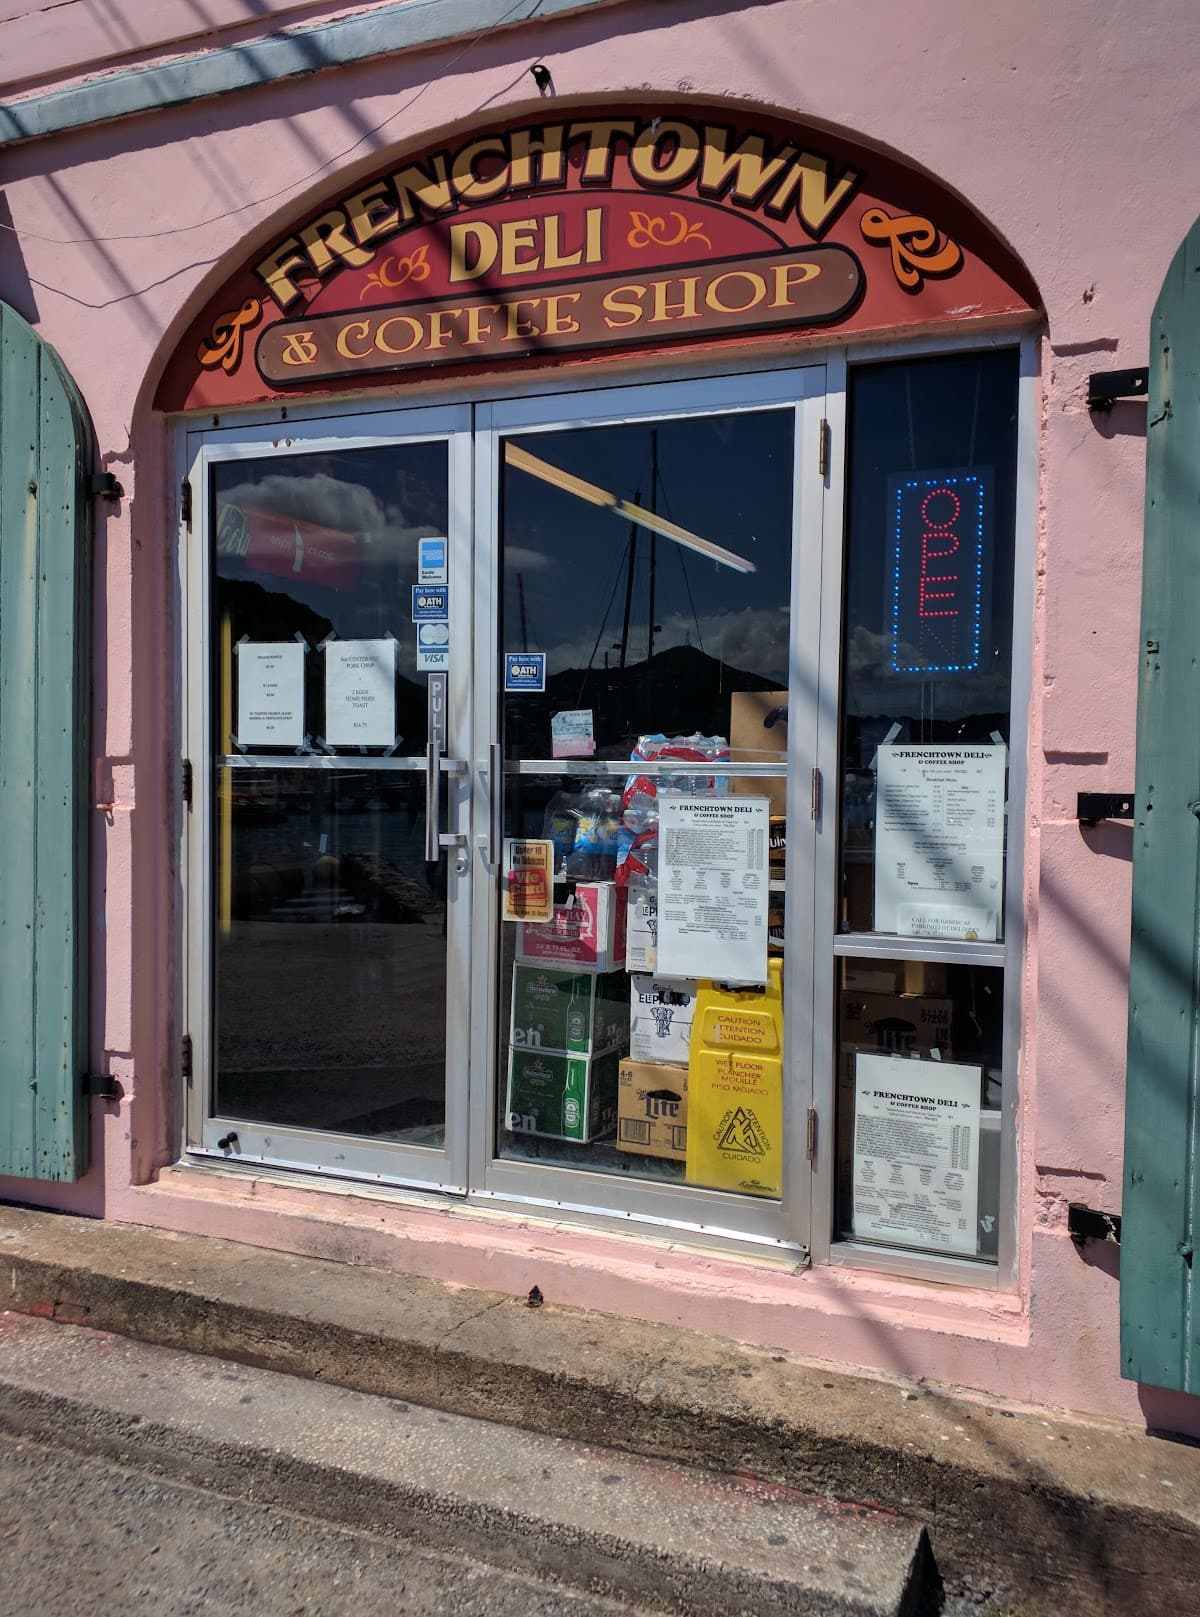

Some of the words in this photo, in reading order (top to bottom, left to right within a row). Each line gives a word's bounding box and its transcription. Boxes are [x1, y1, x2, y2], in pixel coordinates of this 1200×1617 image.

[255, 118, 862, 308] FRENCHTOWN
[449, 206, 604, 283] DELI
[282, 331, 319, 366] &
[336, 293, 583, 360] COFFEE
[602, 262, 823, 330] SHOP
[920, 488, 960, 663] OPEN
[426, 597, 442, 606] ATH
[424, 654, 444, 663] VISA
[520, 666, 537, 675] ATH
[963, 751, 984, 759] DELI
[679, 805, 733, 813] FRENCHTOWN
[515, 871, 541, 884] We
[717, 1015, 761, 1026] CAUTION
[713, 1024, 766, 1036] TTENTION
[735, 1062, 763, 1071] FLOOR
[873, 1090, 936, 1105] FRENCHTOWN
[937, 1099, 959, 1108] DELI
[645, 1097, 680, 1120] Lite
[713, 1110, 733, 1142] CAUTION
[745, 1108, 771, 1151] ATTENTION
[722, 1152, 761, 1164] CUIDADO
